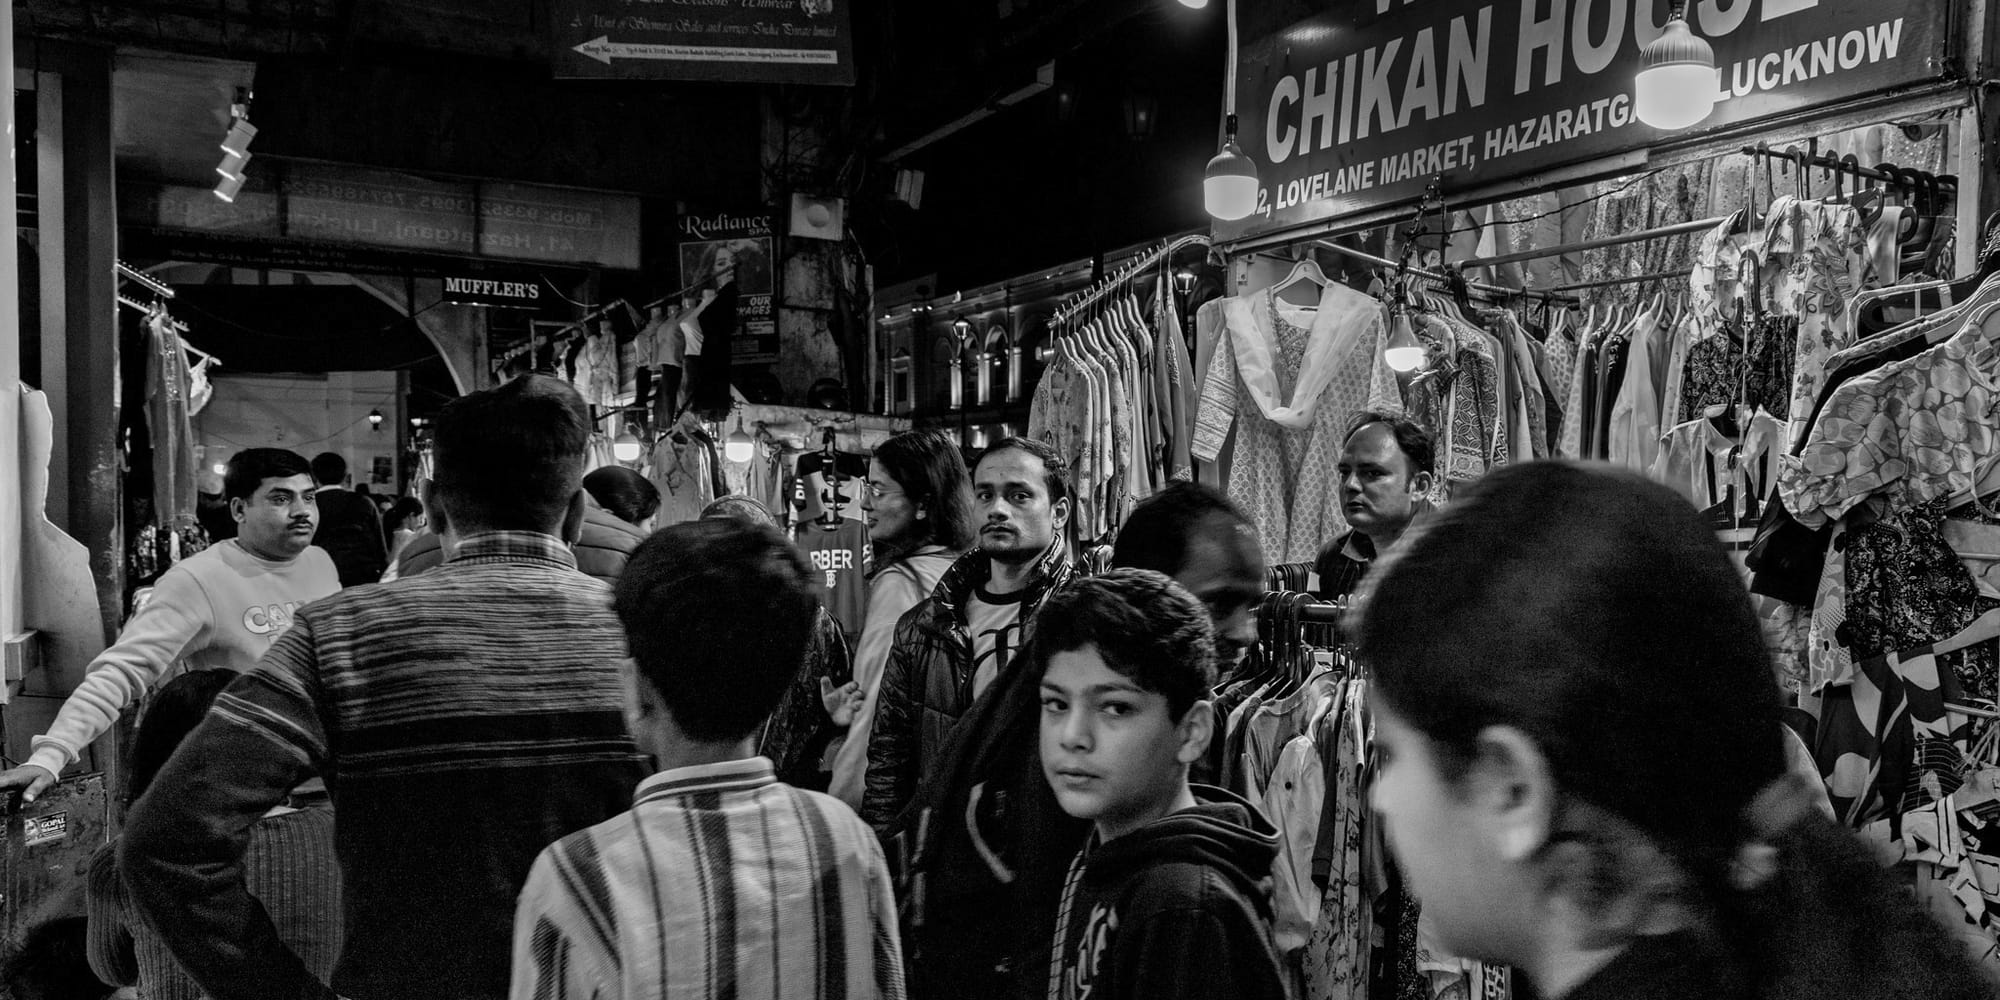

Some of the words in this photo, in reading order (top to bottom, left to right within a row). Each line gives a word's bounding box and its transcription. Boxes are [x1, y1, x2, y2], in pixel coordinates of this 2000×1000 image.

[1265, 5, 1493, 164] CHIKAN
[1252, 188, 1271, 218] 2,
[1276, 160, 1375, 210] LOVELANE
[1380, 134, 1476, 186] MARKET,
[1713, 18, 1903, 103] LUCKNOW
[679, 213, 771, 239] Radiance
[445, 277, 539, 299] MUFFLER'S
[736, 306, 772, 317] KAGES
[749, 295, 771, 306] OUR
